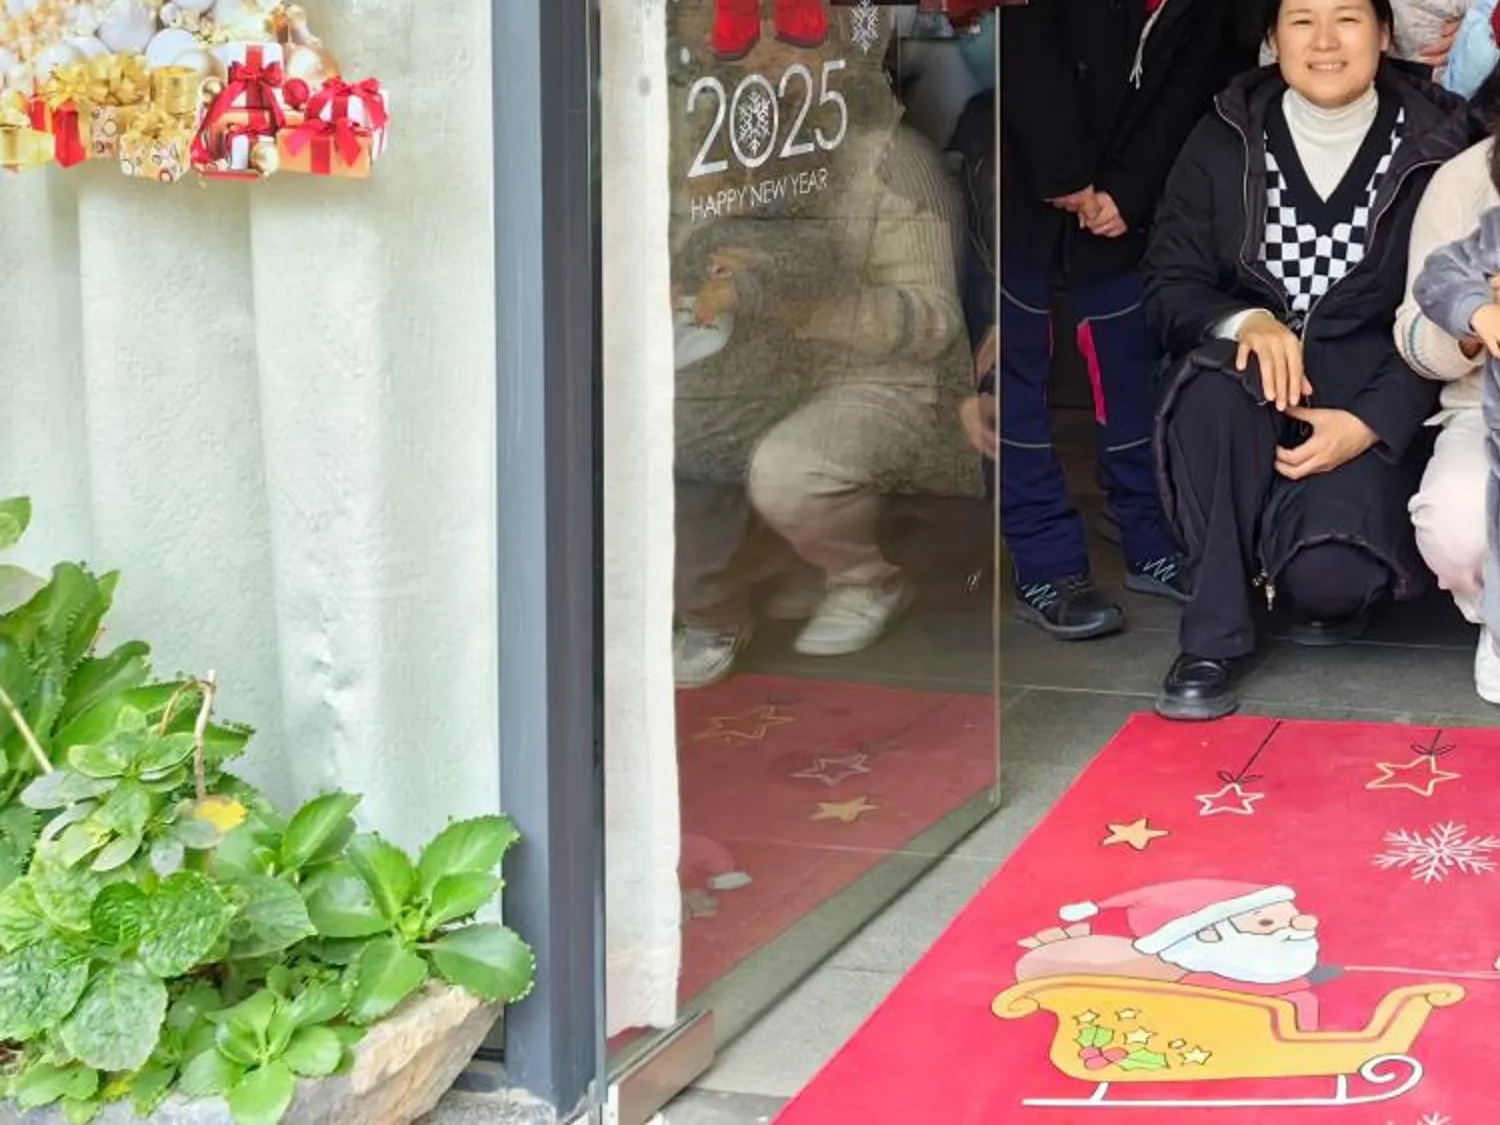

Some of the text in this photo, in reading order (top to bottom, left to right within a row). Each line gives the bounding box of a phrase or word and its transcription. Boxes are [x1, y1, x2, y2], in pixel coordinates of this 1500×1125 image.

[686, 58, 848, 178] 2025
[690, 168, 829, 221] HAPPY NEW YEAR
